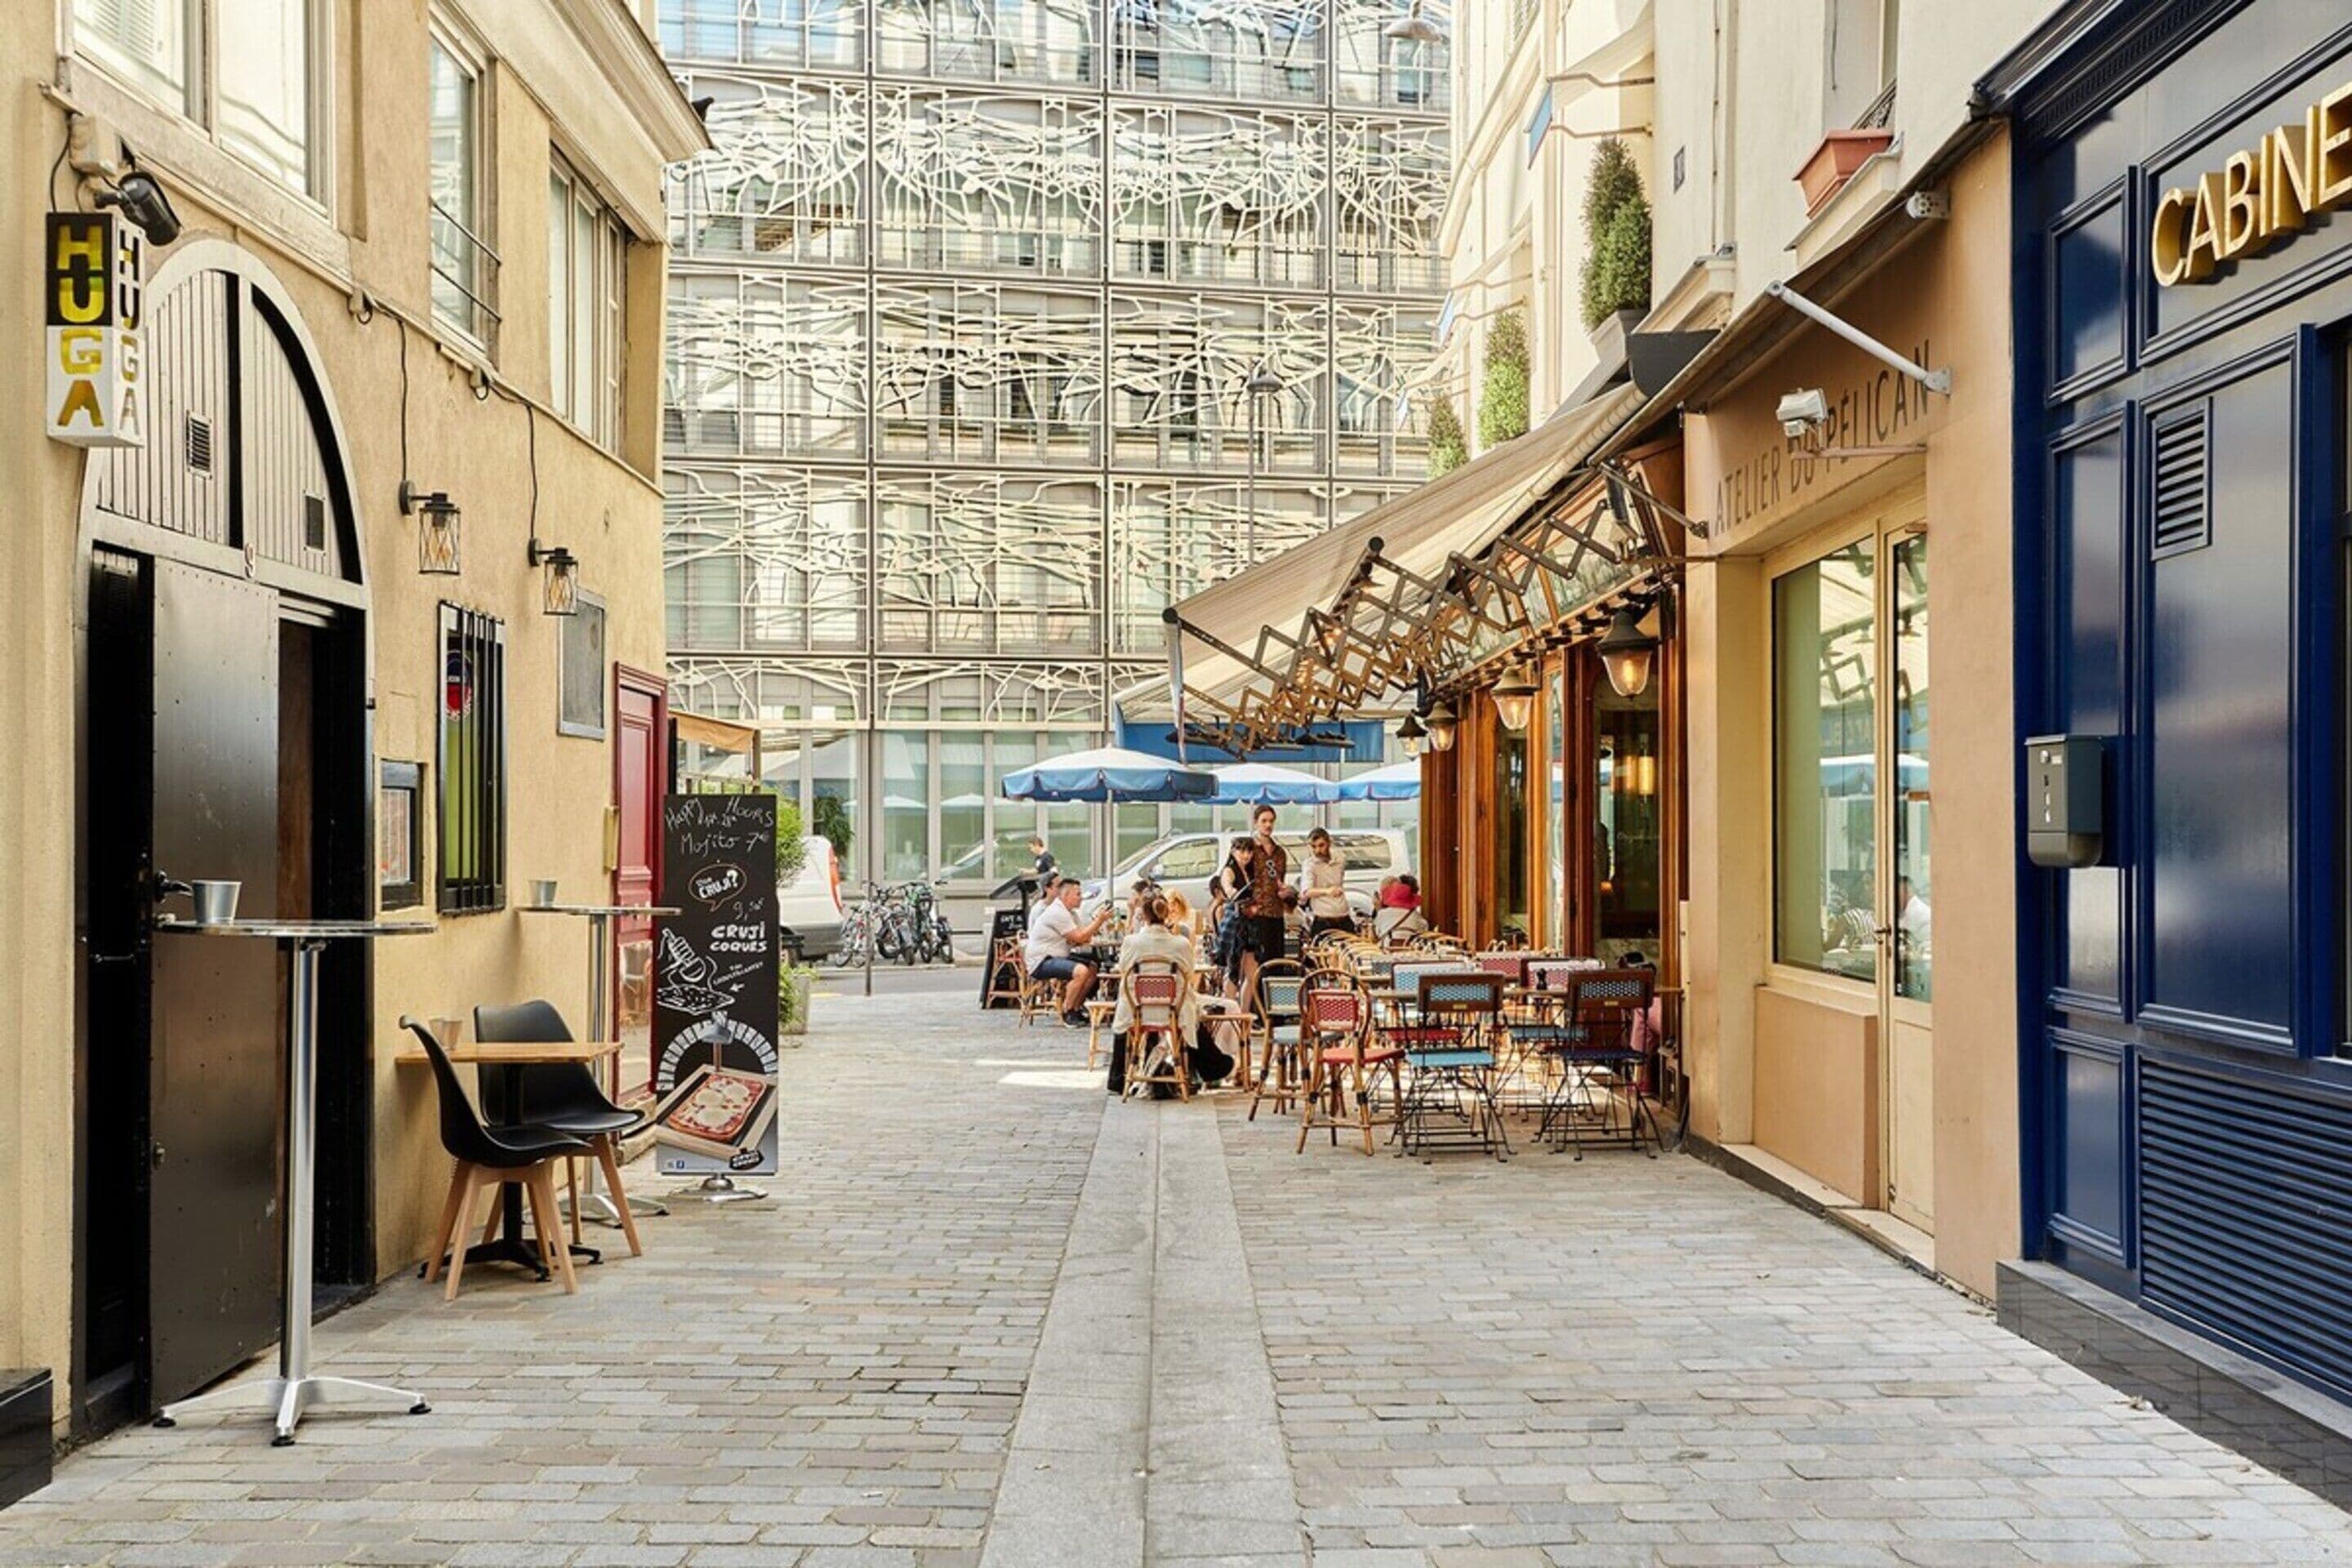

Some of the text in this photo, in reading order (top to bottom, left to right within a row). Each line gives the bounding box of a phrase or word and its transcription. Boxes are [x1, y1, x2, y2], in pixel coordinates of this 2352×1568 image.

[2151, 81, 2352, 287] CABINE
[56, 224, 105, 427] HUGA
[118, 229, 140, 436] HUGA
[1716, 446, 1780, 536] ATELIER
[1790, 434, 1815, 494] DU
[680, 830, 741, 858] Mojito
[709, 940, 768, 953] COQUES
